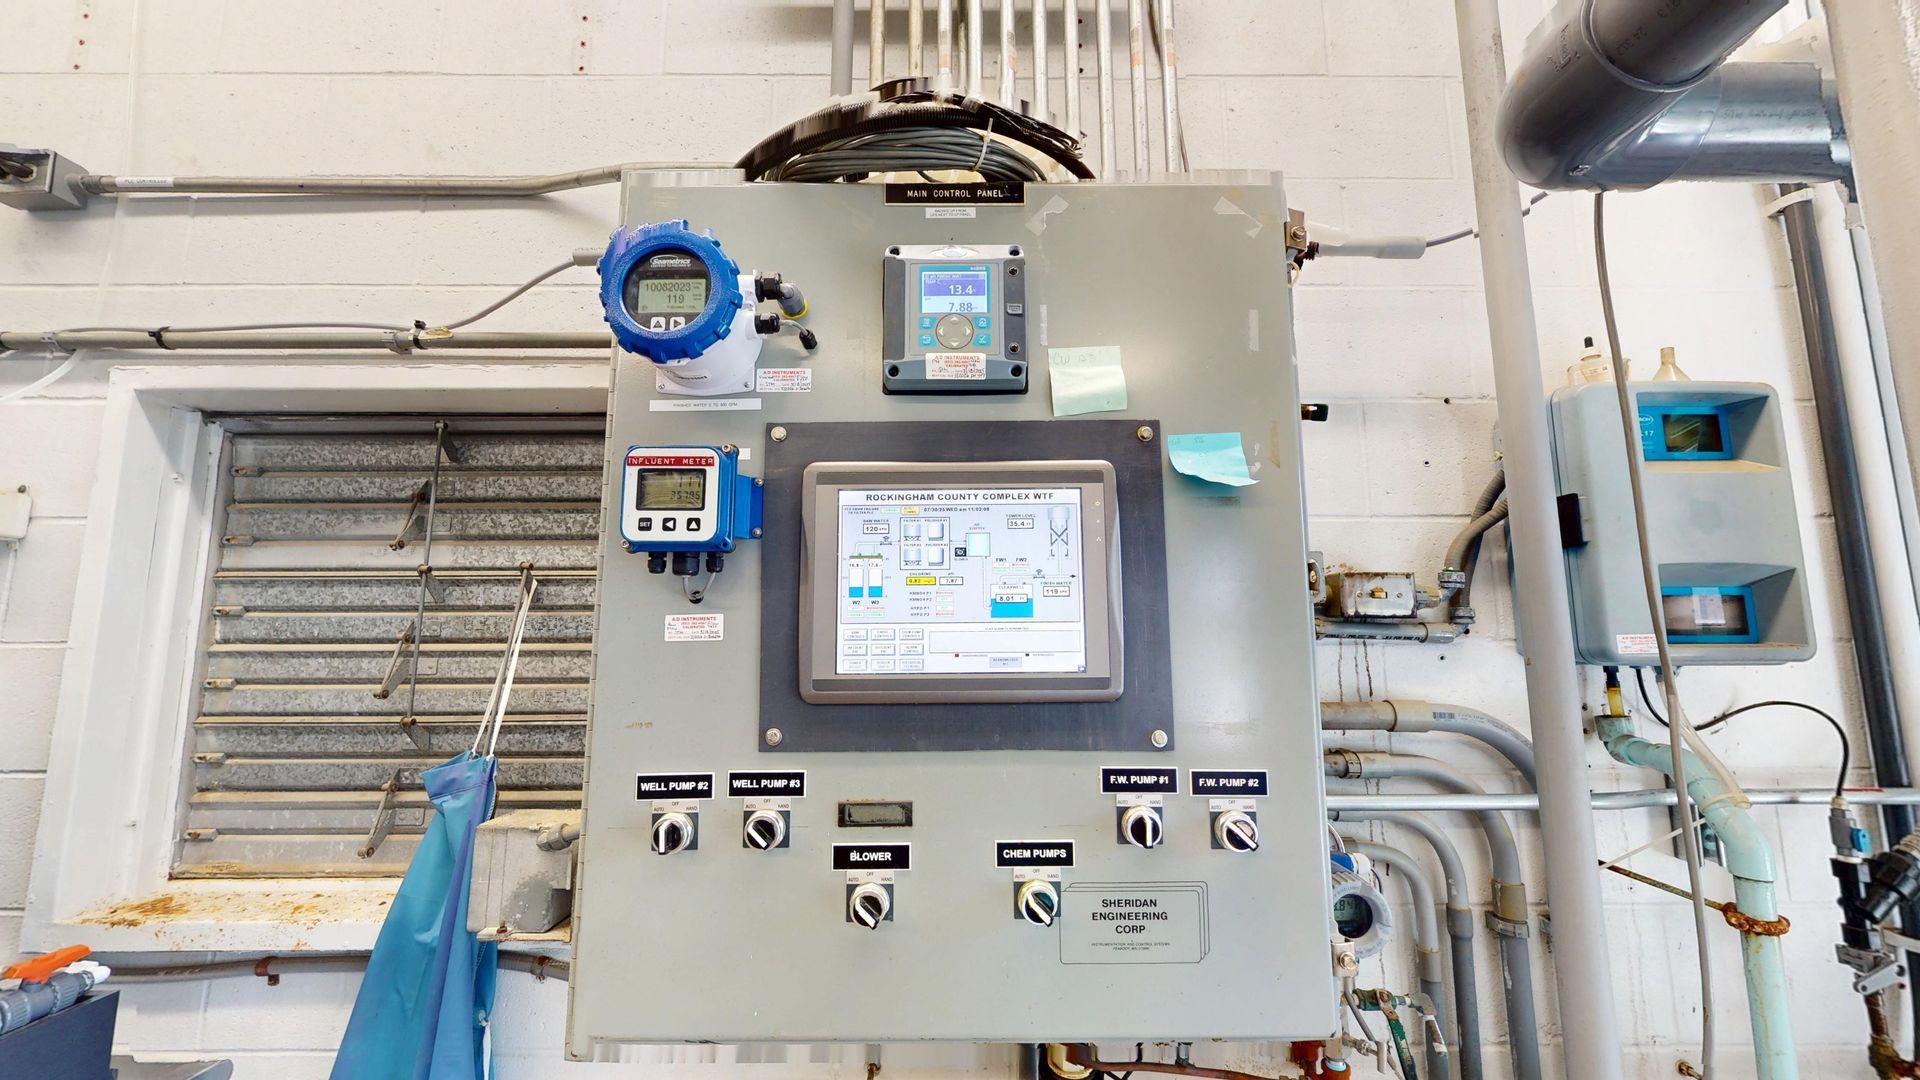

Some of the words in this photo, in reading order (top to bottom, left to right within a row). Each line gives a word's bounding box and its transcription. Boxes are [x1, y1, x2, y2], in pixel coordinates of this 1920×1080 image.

[907, 189, 927, 198] MAIN
[933, 189, 971, 198] CONTROL
[977, 189, 1003, 198] PANEL
[651, 257, 691, 265] Seametrics
[645, 281, 691, 292] 10082023
[949, 285, 973, 295] 13.4
[667, 294, 684, 303] 119
[949, 302, 973, 312] 7.88
[628, 457, 675, 466] INFLUENT
[682, 457, 713, 465] METER
[866, 493, 934, 501] ROCKINGHAM
[937, 493, 979, 501] COUNTY
[1033, 492, 1054, 500] WTF
[733, 779, 759, 788] WELL
[761, 779, 787, 788] PUMP
[789, 779, 800, 788] #3
[1110, 775, 1128, 784] F.W.
[1130, 775, 1157, 784] PUMP
[1159, 775, 1169, 784] #1
[1199, 778, 1217, 787] F.W.
[1219, 778, 1246, 787] PUMP
[1248, 778, 1259, 787] #2
[641, 782, 667, 791] WELL
[669, 782, 696, 790] PUMP
[698, 781, 709, 790] #2
[850, 851, 892, 861] BLOWER
[1003, 849, 1031, 858] CHEM
[1033, 849, 1066, 858] PUMPS
[1101, 898, 1157, 907] SHERIDAN
[1092, 912, 1168, 921] ENGINEERING
[1115, 925, 1146, 934] CORP
